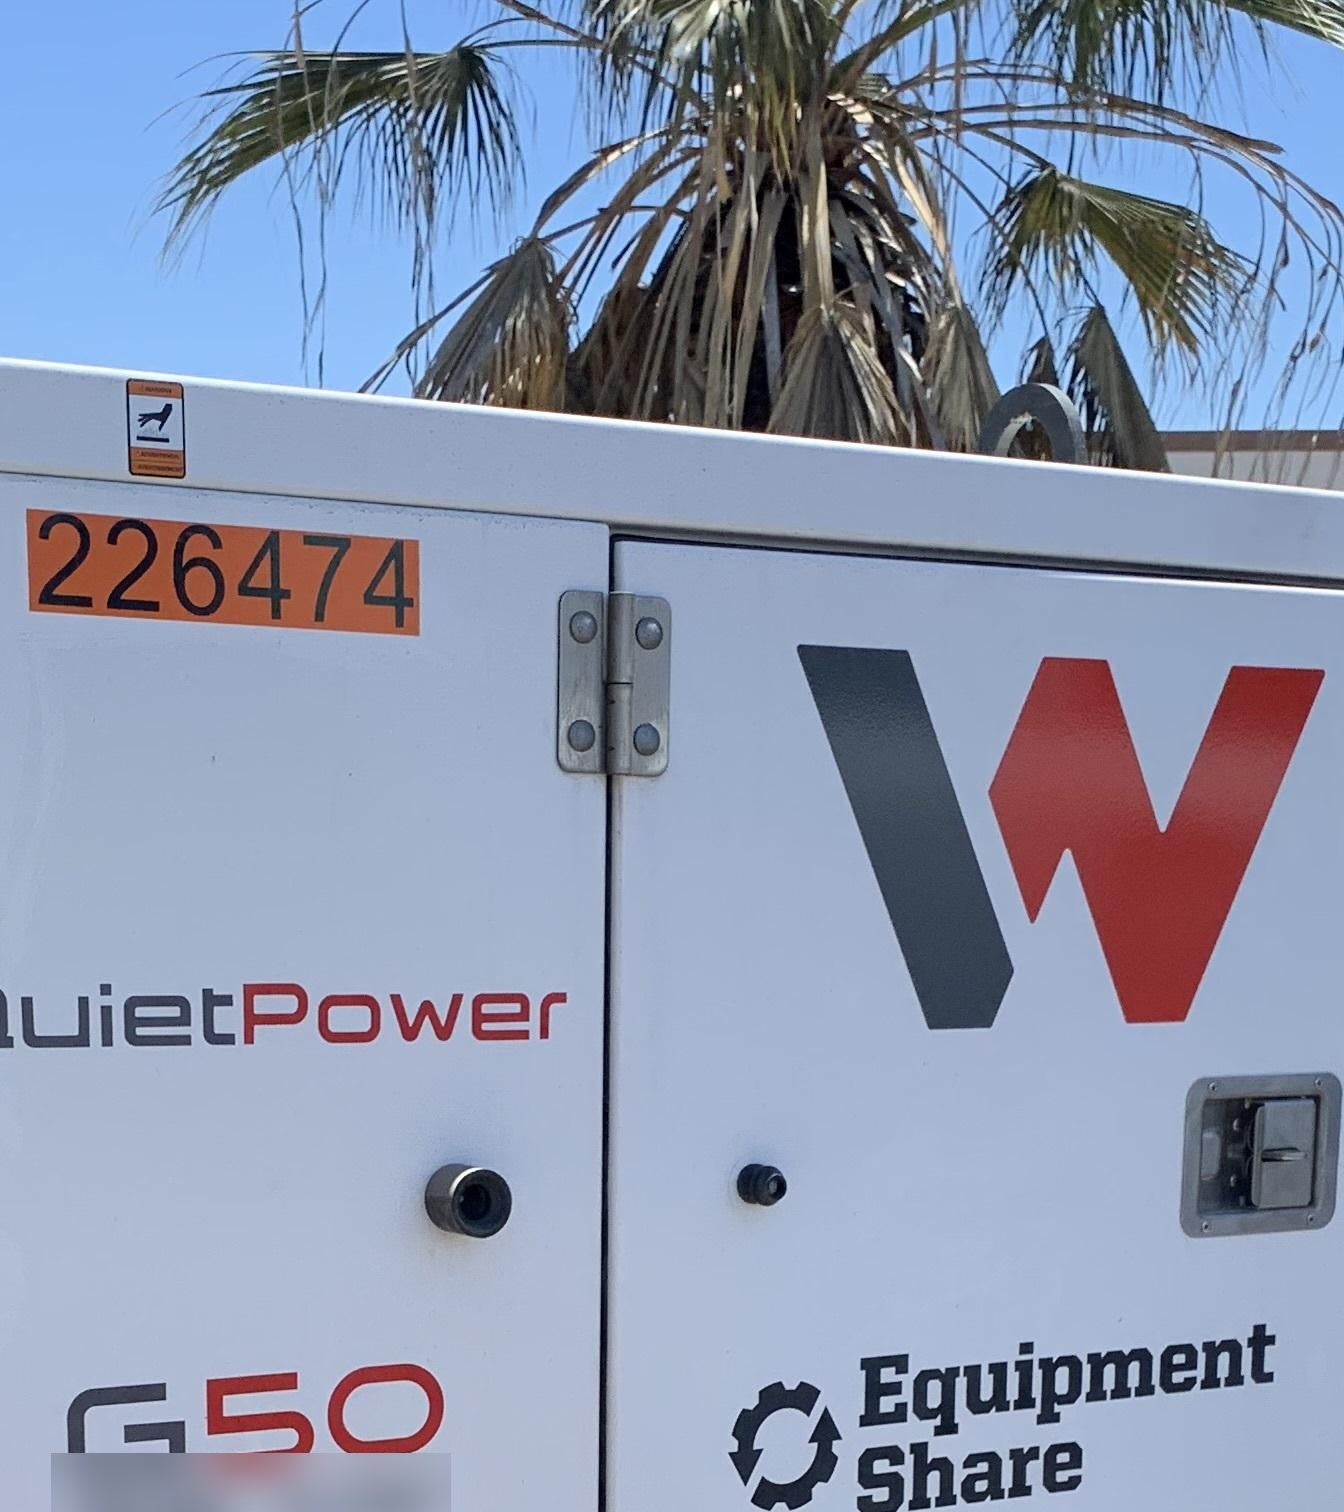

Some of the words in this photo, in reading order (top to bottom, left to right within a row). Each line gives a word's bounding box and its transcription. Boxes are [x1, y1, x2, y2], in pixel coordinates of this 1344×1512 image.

[38, 513, 414, 628] 226474
[67, 1363, 445, 1453] G50
[858, 1323, 1276, 1436] Equipment
